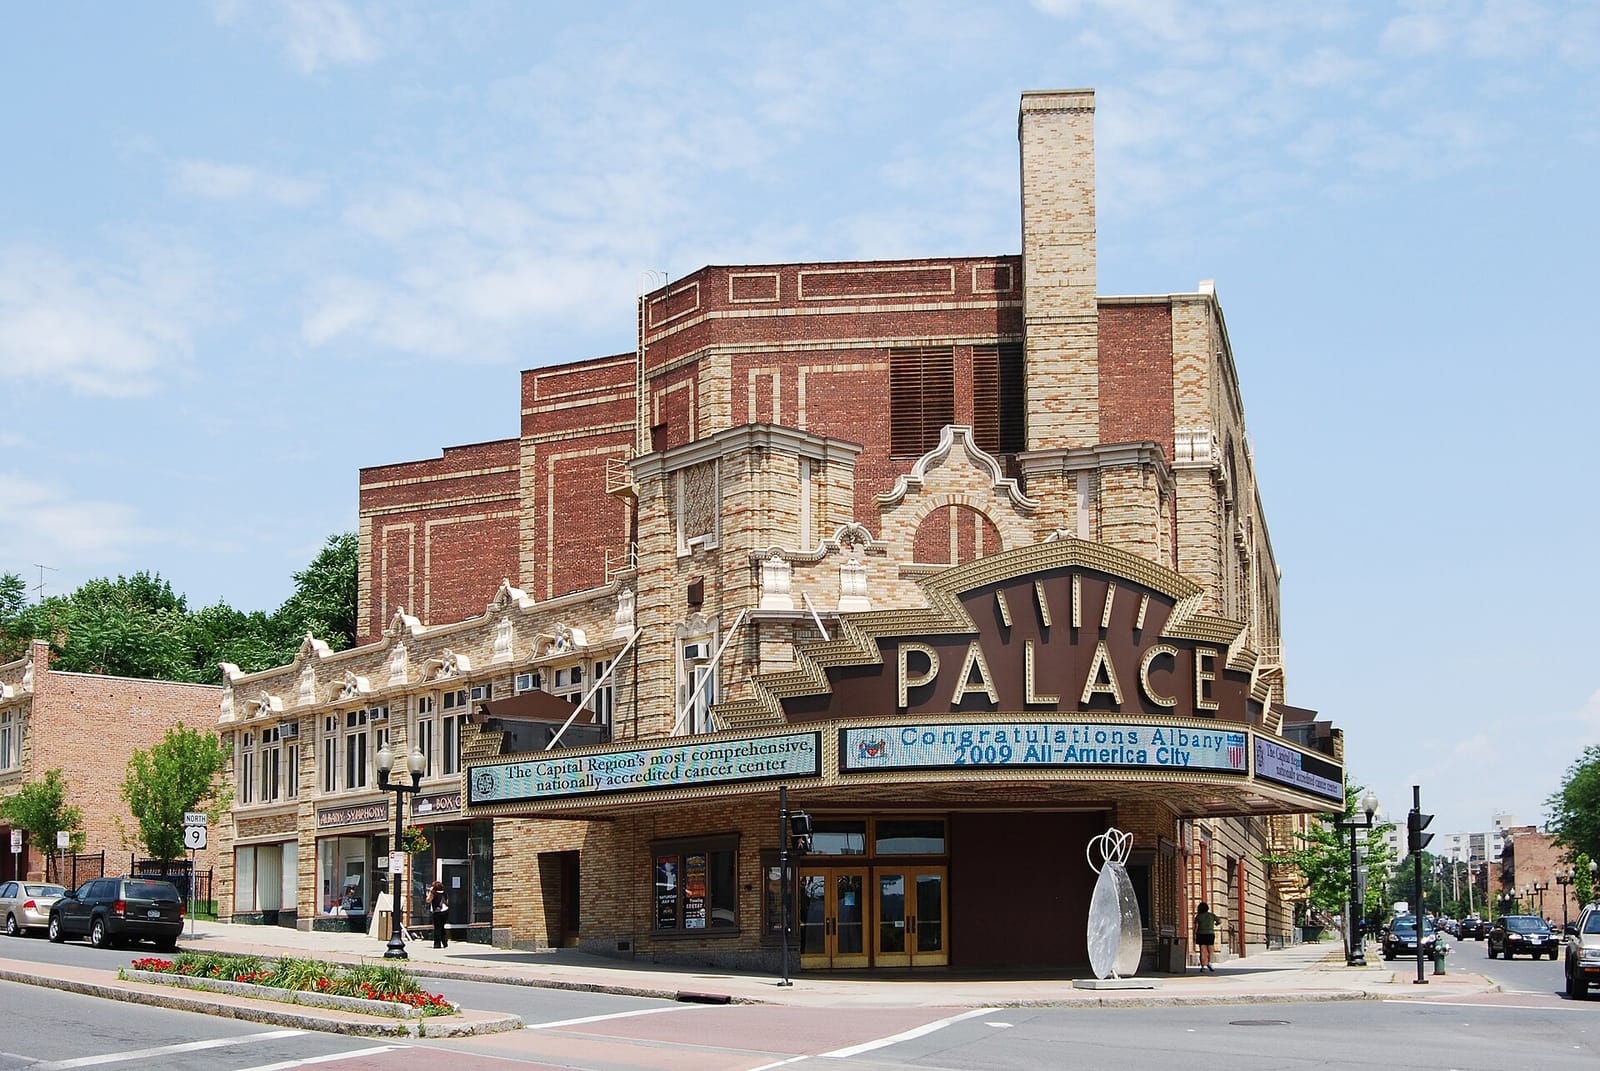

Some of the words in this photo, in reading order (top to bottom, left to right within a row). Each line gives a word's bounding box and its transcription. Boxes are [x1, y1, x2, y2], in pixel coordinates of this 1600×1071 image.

[898, 639, 1220, 710] PALACE
[901, 725, 1138, 747] Congratulations
[1151, 728, 1223, 751] Albany
[505, 765, 531, 779] The
[536, 759, 583, 779] Capital
[587, 753, 645, 774] Region's
[650, 751, 686, 766] most
[691, 738, 813, 763] comprehensive,
[954, 744, 1012, 765] 2009
[1024, 744, 1147, 764] All-America
[1156, 747, 1191, 766] City
[536, 774, 601, 791] nationally
[606, 765, 679, 786] accredited
[684, 763, 733, 778] cancer
[738, 758, 787, 774] center
[435, 796, 453, 811] BOX
[186, 815, 206, 823] NORTH
[320, 811, 345, 825] ALBANY
[346, 806, 385, 821] SYMPHONY
[192, 830, 200, 844] 9
